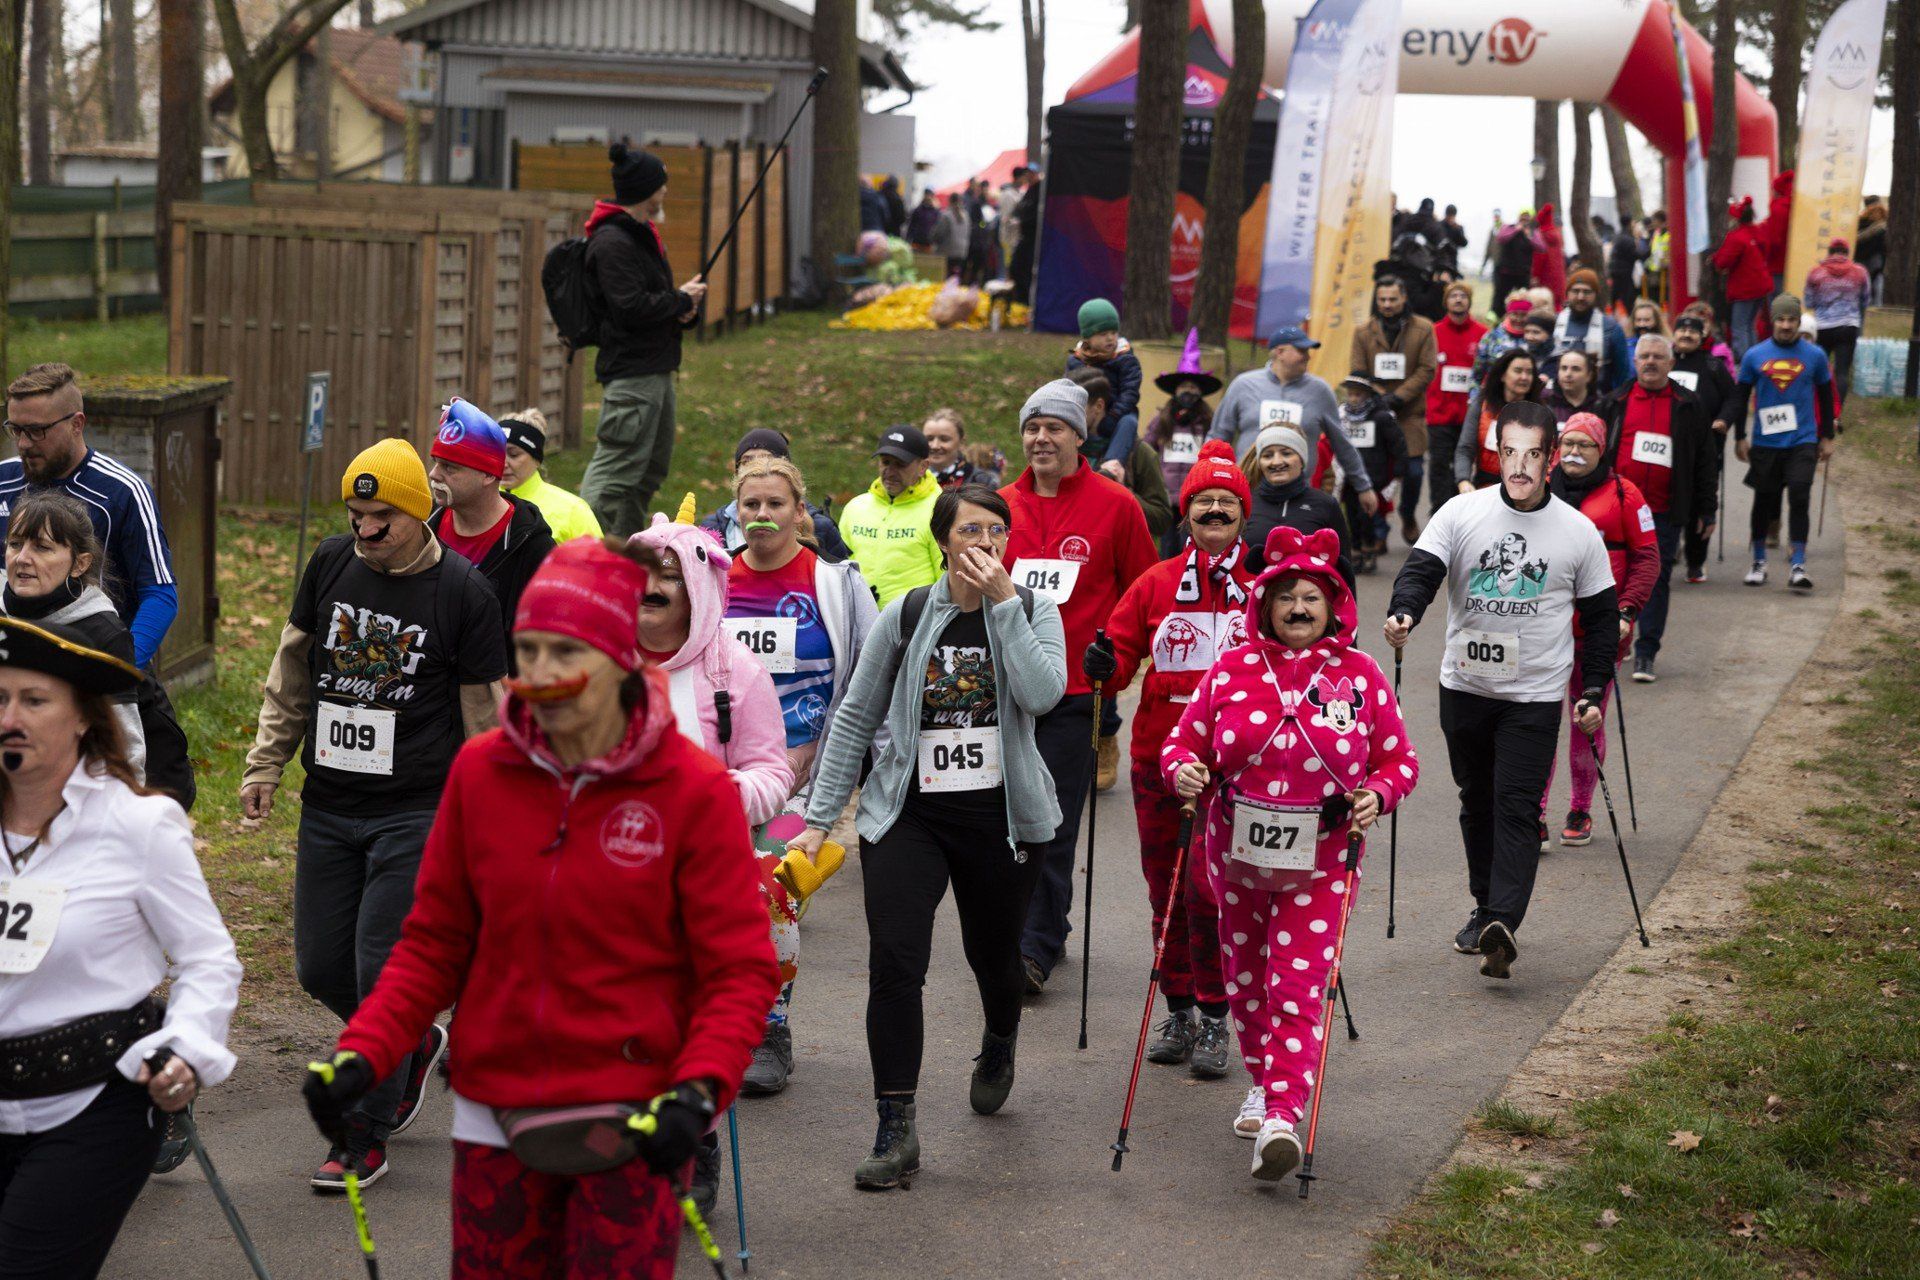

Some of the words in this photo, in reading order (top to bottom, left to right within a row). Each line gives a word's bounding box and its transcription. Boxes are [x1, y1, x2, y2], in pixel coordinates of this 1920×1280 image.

[1301, 96, 1321, 159] TRAIL
[1289, 171, 1314, 258] WINTER
[310, 385, 324, 425] P
[1767, 412, 1788, 426] 044
[1642, 440, 1666, 455] 002
[852, 525, 878, 539] RAMI
[886, 527, 917, 540] RENT
[1025, 570, 1060, 590] 014
[736, 630, 777, 654] 016
[1467, 641, 1505, 663] 003
[330, 719, 376, 751] 009
[933, 742, 984, 771] 045
[1248, 821, 1300, 850] 027
